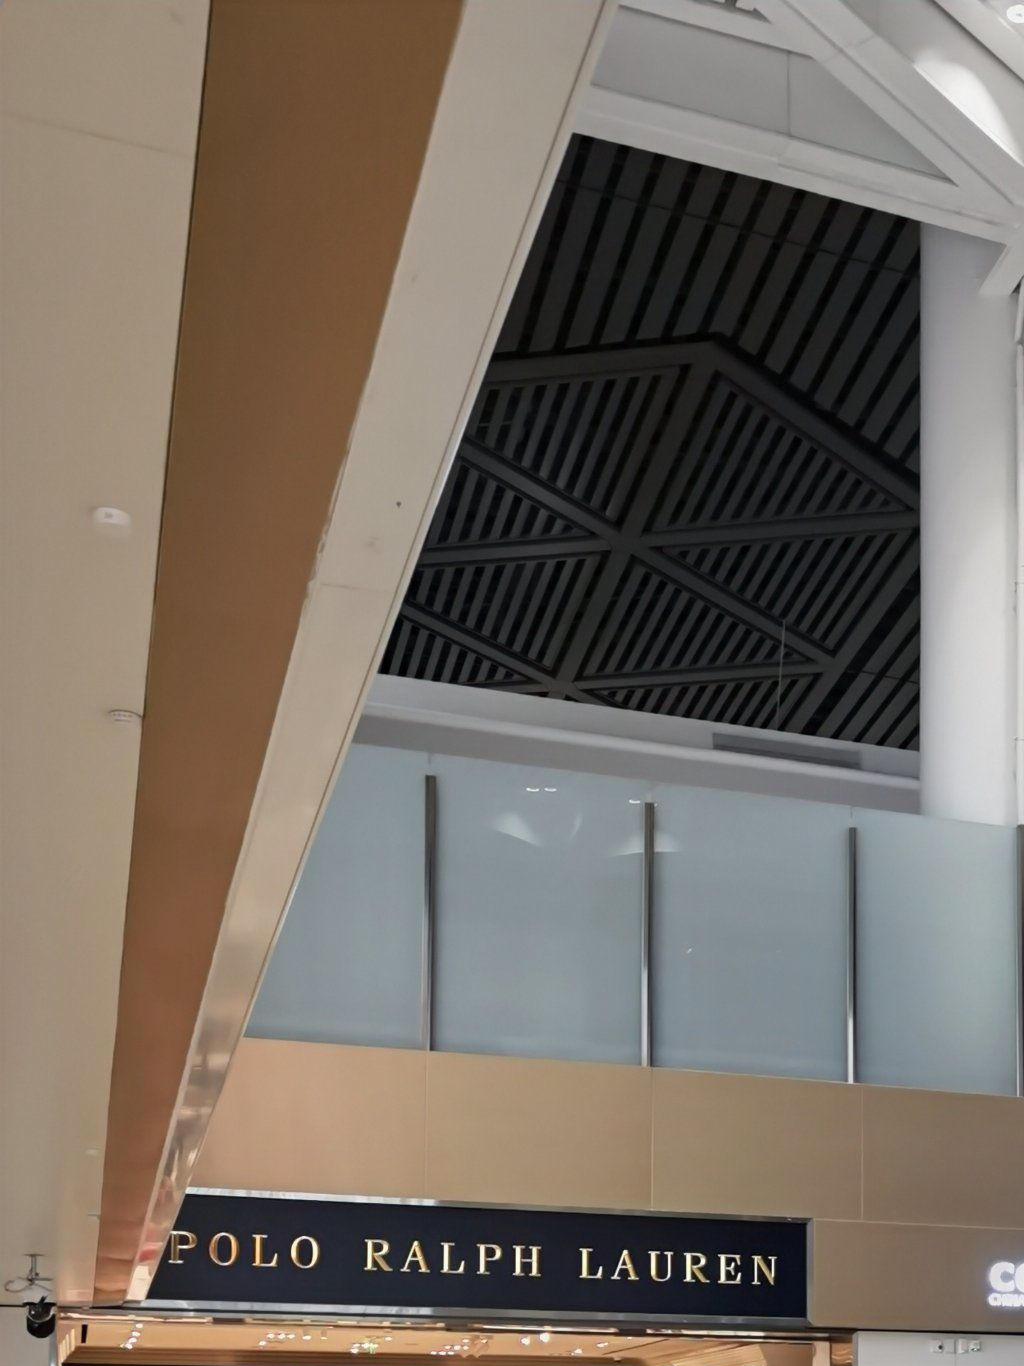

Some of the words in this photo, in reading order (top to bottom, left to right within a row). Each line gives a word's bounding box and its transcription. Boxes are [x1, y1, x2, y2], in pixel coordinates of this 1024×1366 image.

[168, 1230, 320, 1269] POLO
[363, 1238, 542, 1277] RALPH
[579, 1248, 777, 1286] LAUREN
